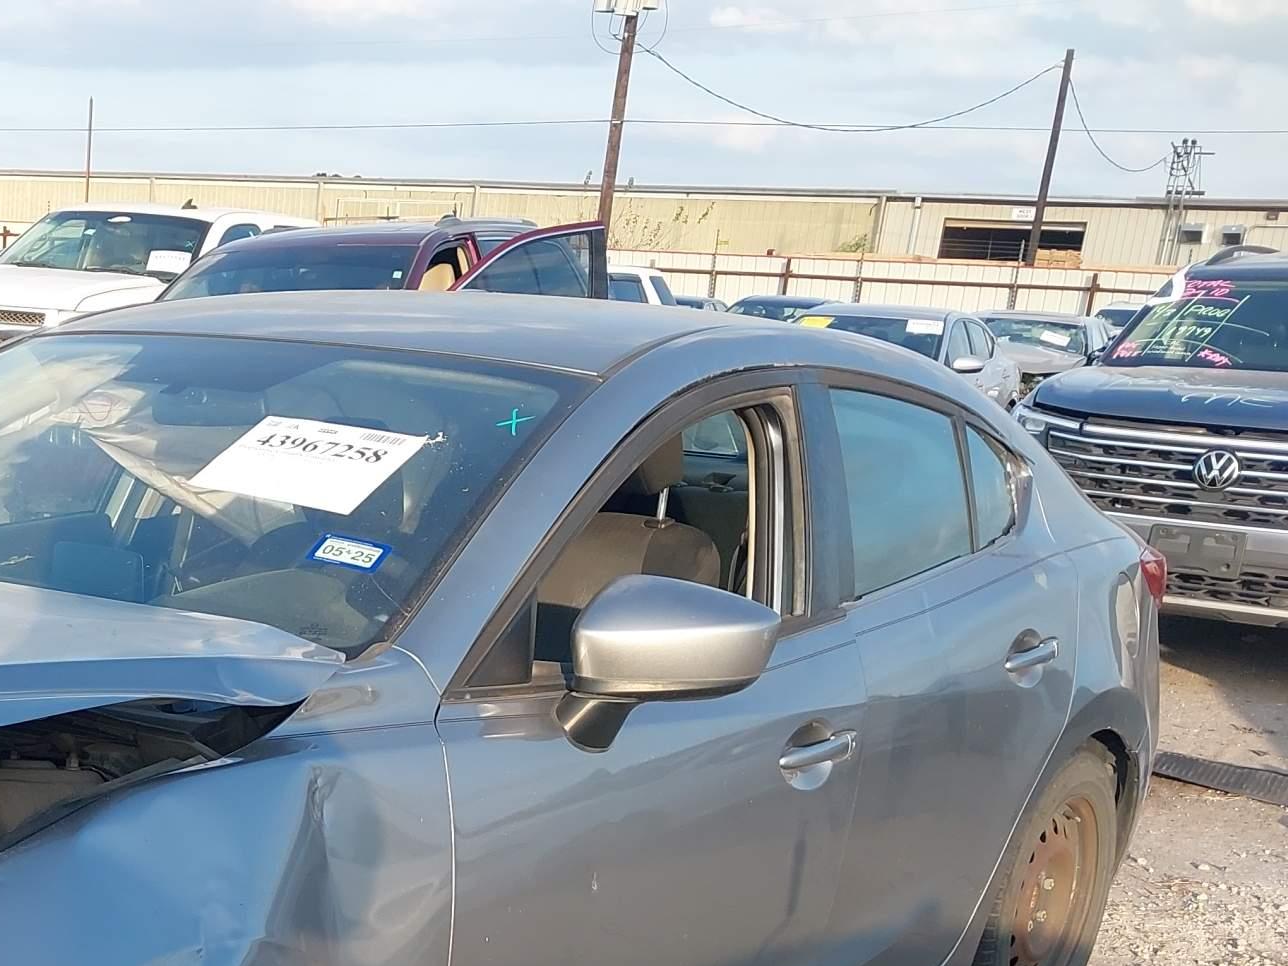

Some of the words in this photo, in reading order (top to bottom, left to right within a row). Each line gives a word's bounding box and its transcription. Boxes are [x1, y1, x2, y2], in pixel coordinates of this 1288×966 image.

[257, 433, 388, 463] 43967258
[322, 544, 346, 557] 05
[351, 550, 376, 563] 25
